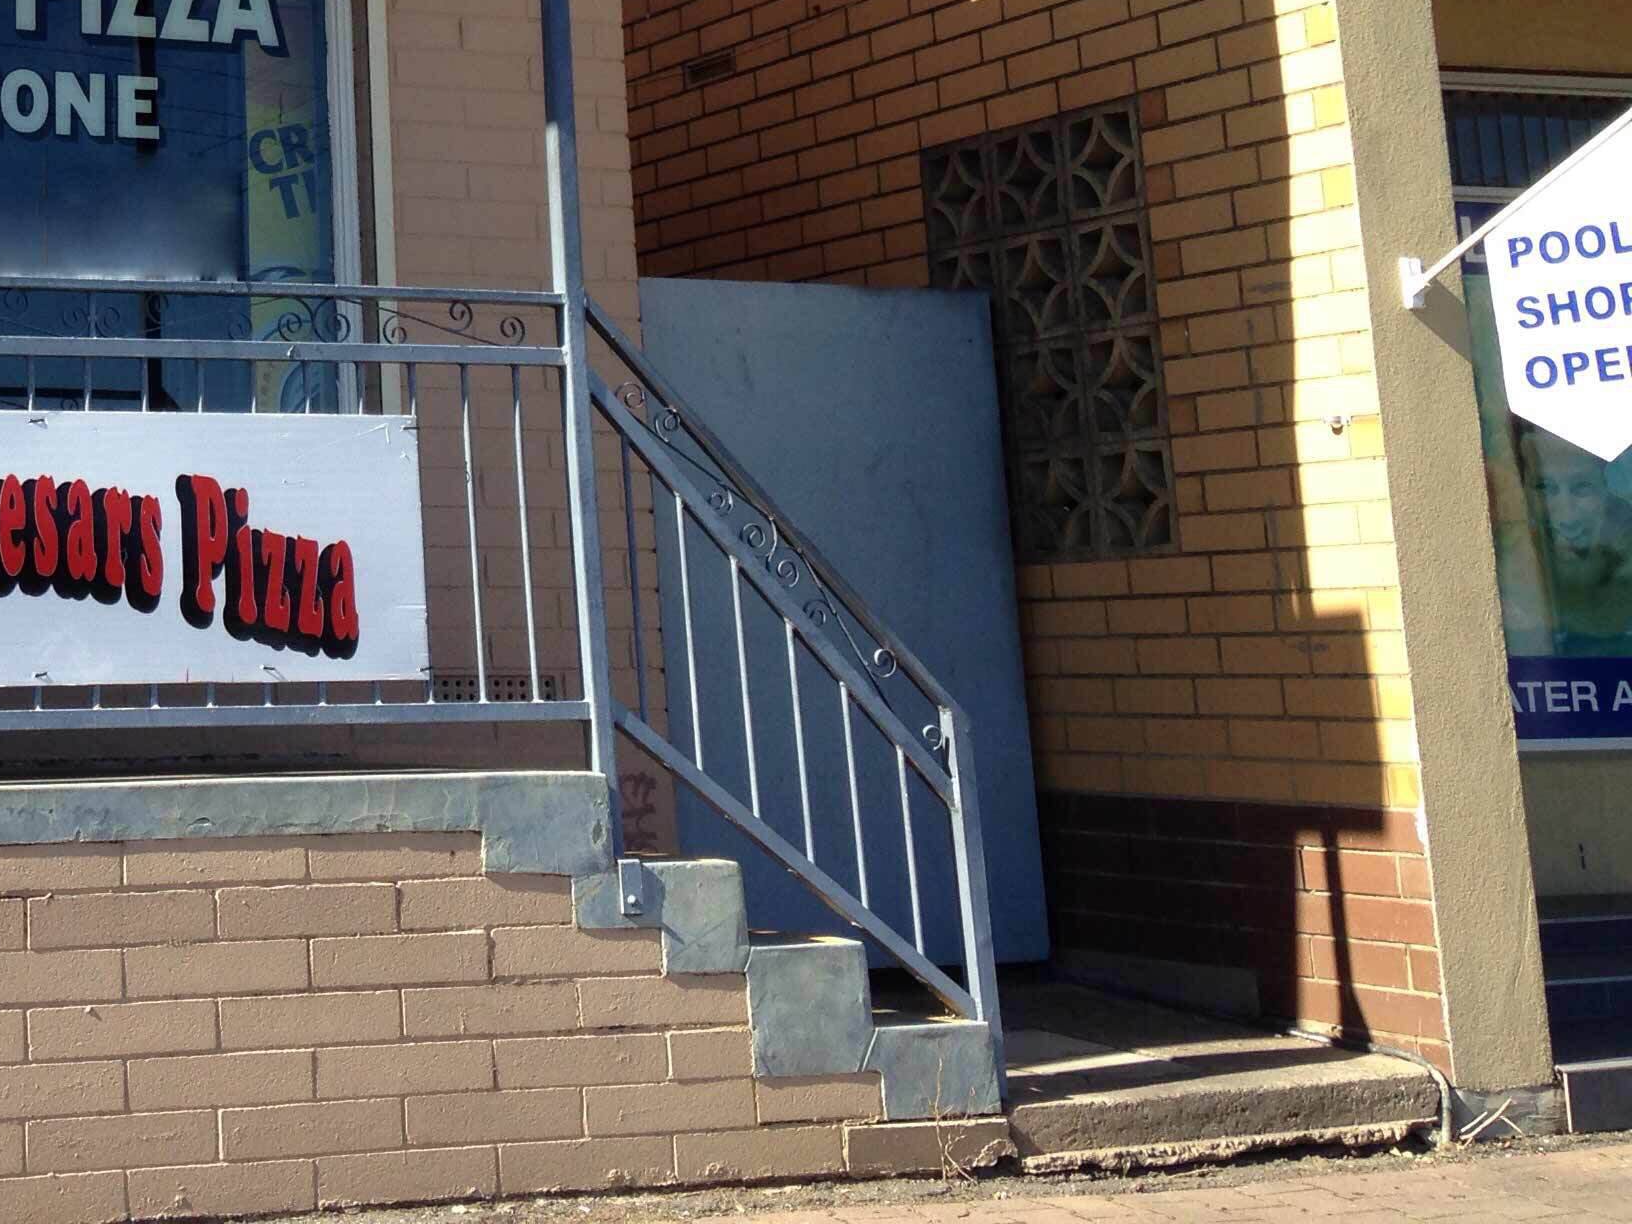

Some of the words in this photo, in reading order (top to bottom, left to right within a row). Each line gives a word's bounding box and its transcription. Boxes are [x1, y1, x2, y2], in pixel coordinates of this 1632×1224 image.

[1507, 221, 1632, 268] POOL
[1525, 345, 1632, 389] OPE
[175, 473, 361, 661] Pizza
